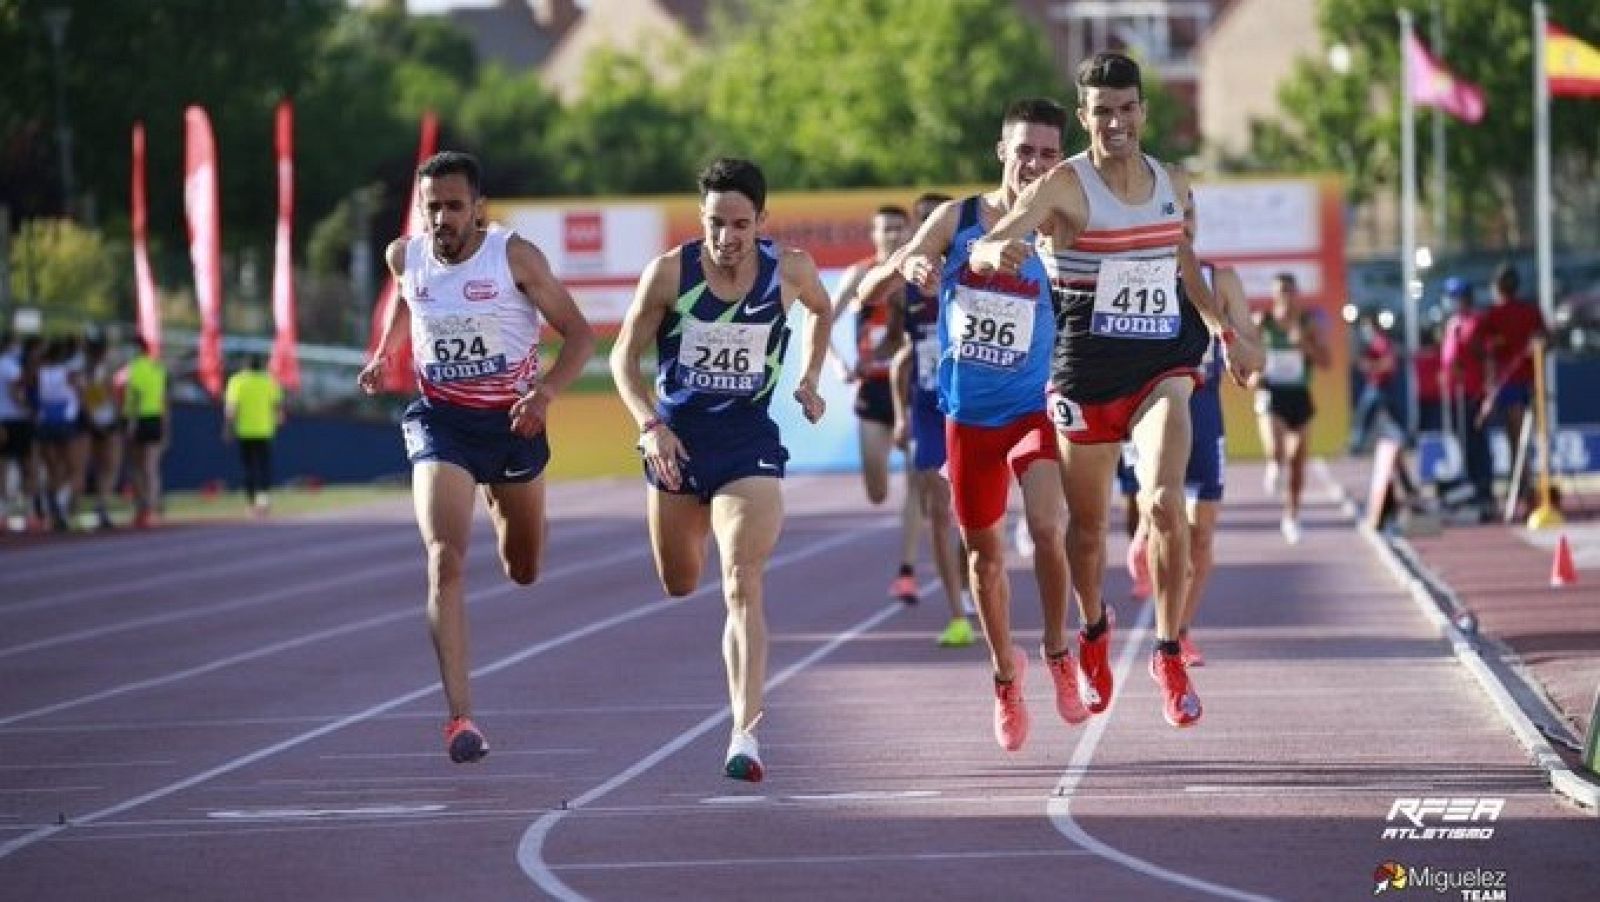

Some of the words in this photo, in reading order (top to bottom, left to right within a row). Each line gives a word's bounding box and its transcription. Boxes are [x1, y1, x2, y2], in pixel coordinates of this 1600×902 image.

[1112, 286, 1167, 314] 419
[961, 314, 1016, 347] 396
[1101, 315, 1173, 333] Joma
[434, 336, 488, 362] 624
[694, 345, 750, 373] 246
[1056, 400, 1074, 427] 9
